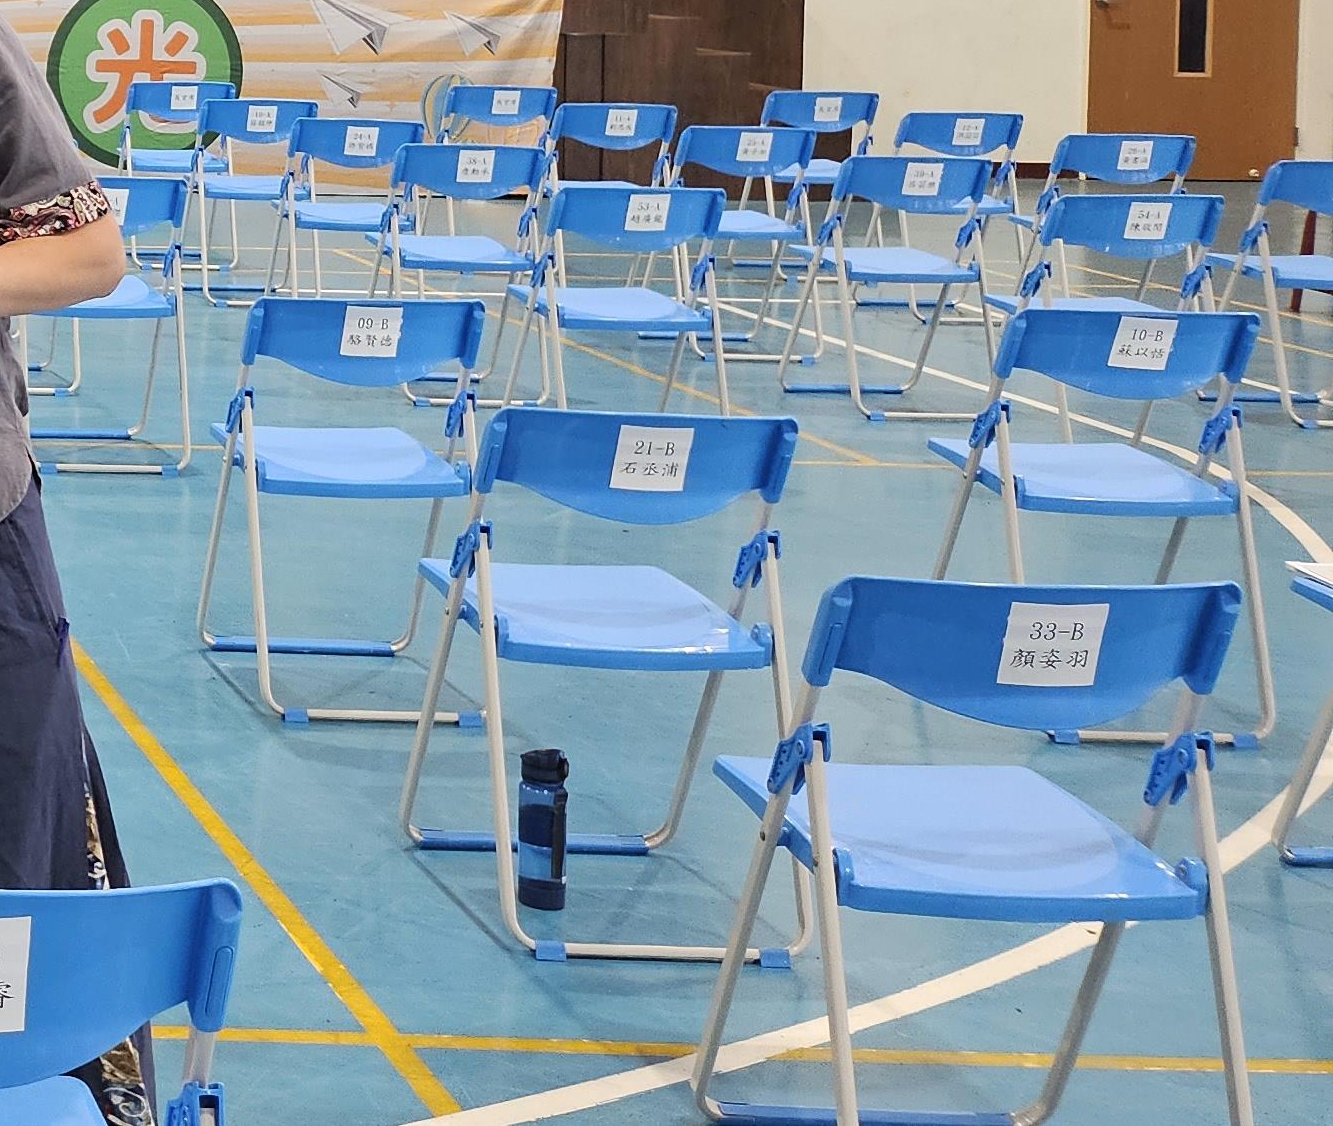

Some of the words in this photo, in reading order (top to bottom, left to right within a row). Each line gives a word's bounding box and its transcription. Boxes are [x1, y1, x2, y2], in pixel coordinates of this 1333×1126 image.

[93, 19, 196, 130] 光
[358, 317, 389, 330] 09-B
[1132, 329, 1164, 341] 10-B
[633, 440, 675, 456] 21-B
[619, 462, 679, 478] 石丞浦
[1029, 621, 1084, 641] 33-B
[1009, 648, 1089, 670] 顏姿羽
